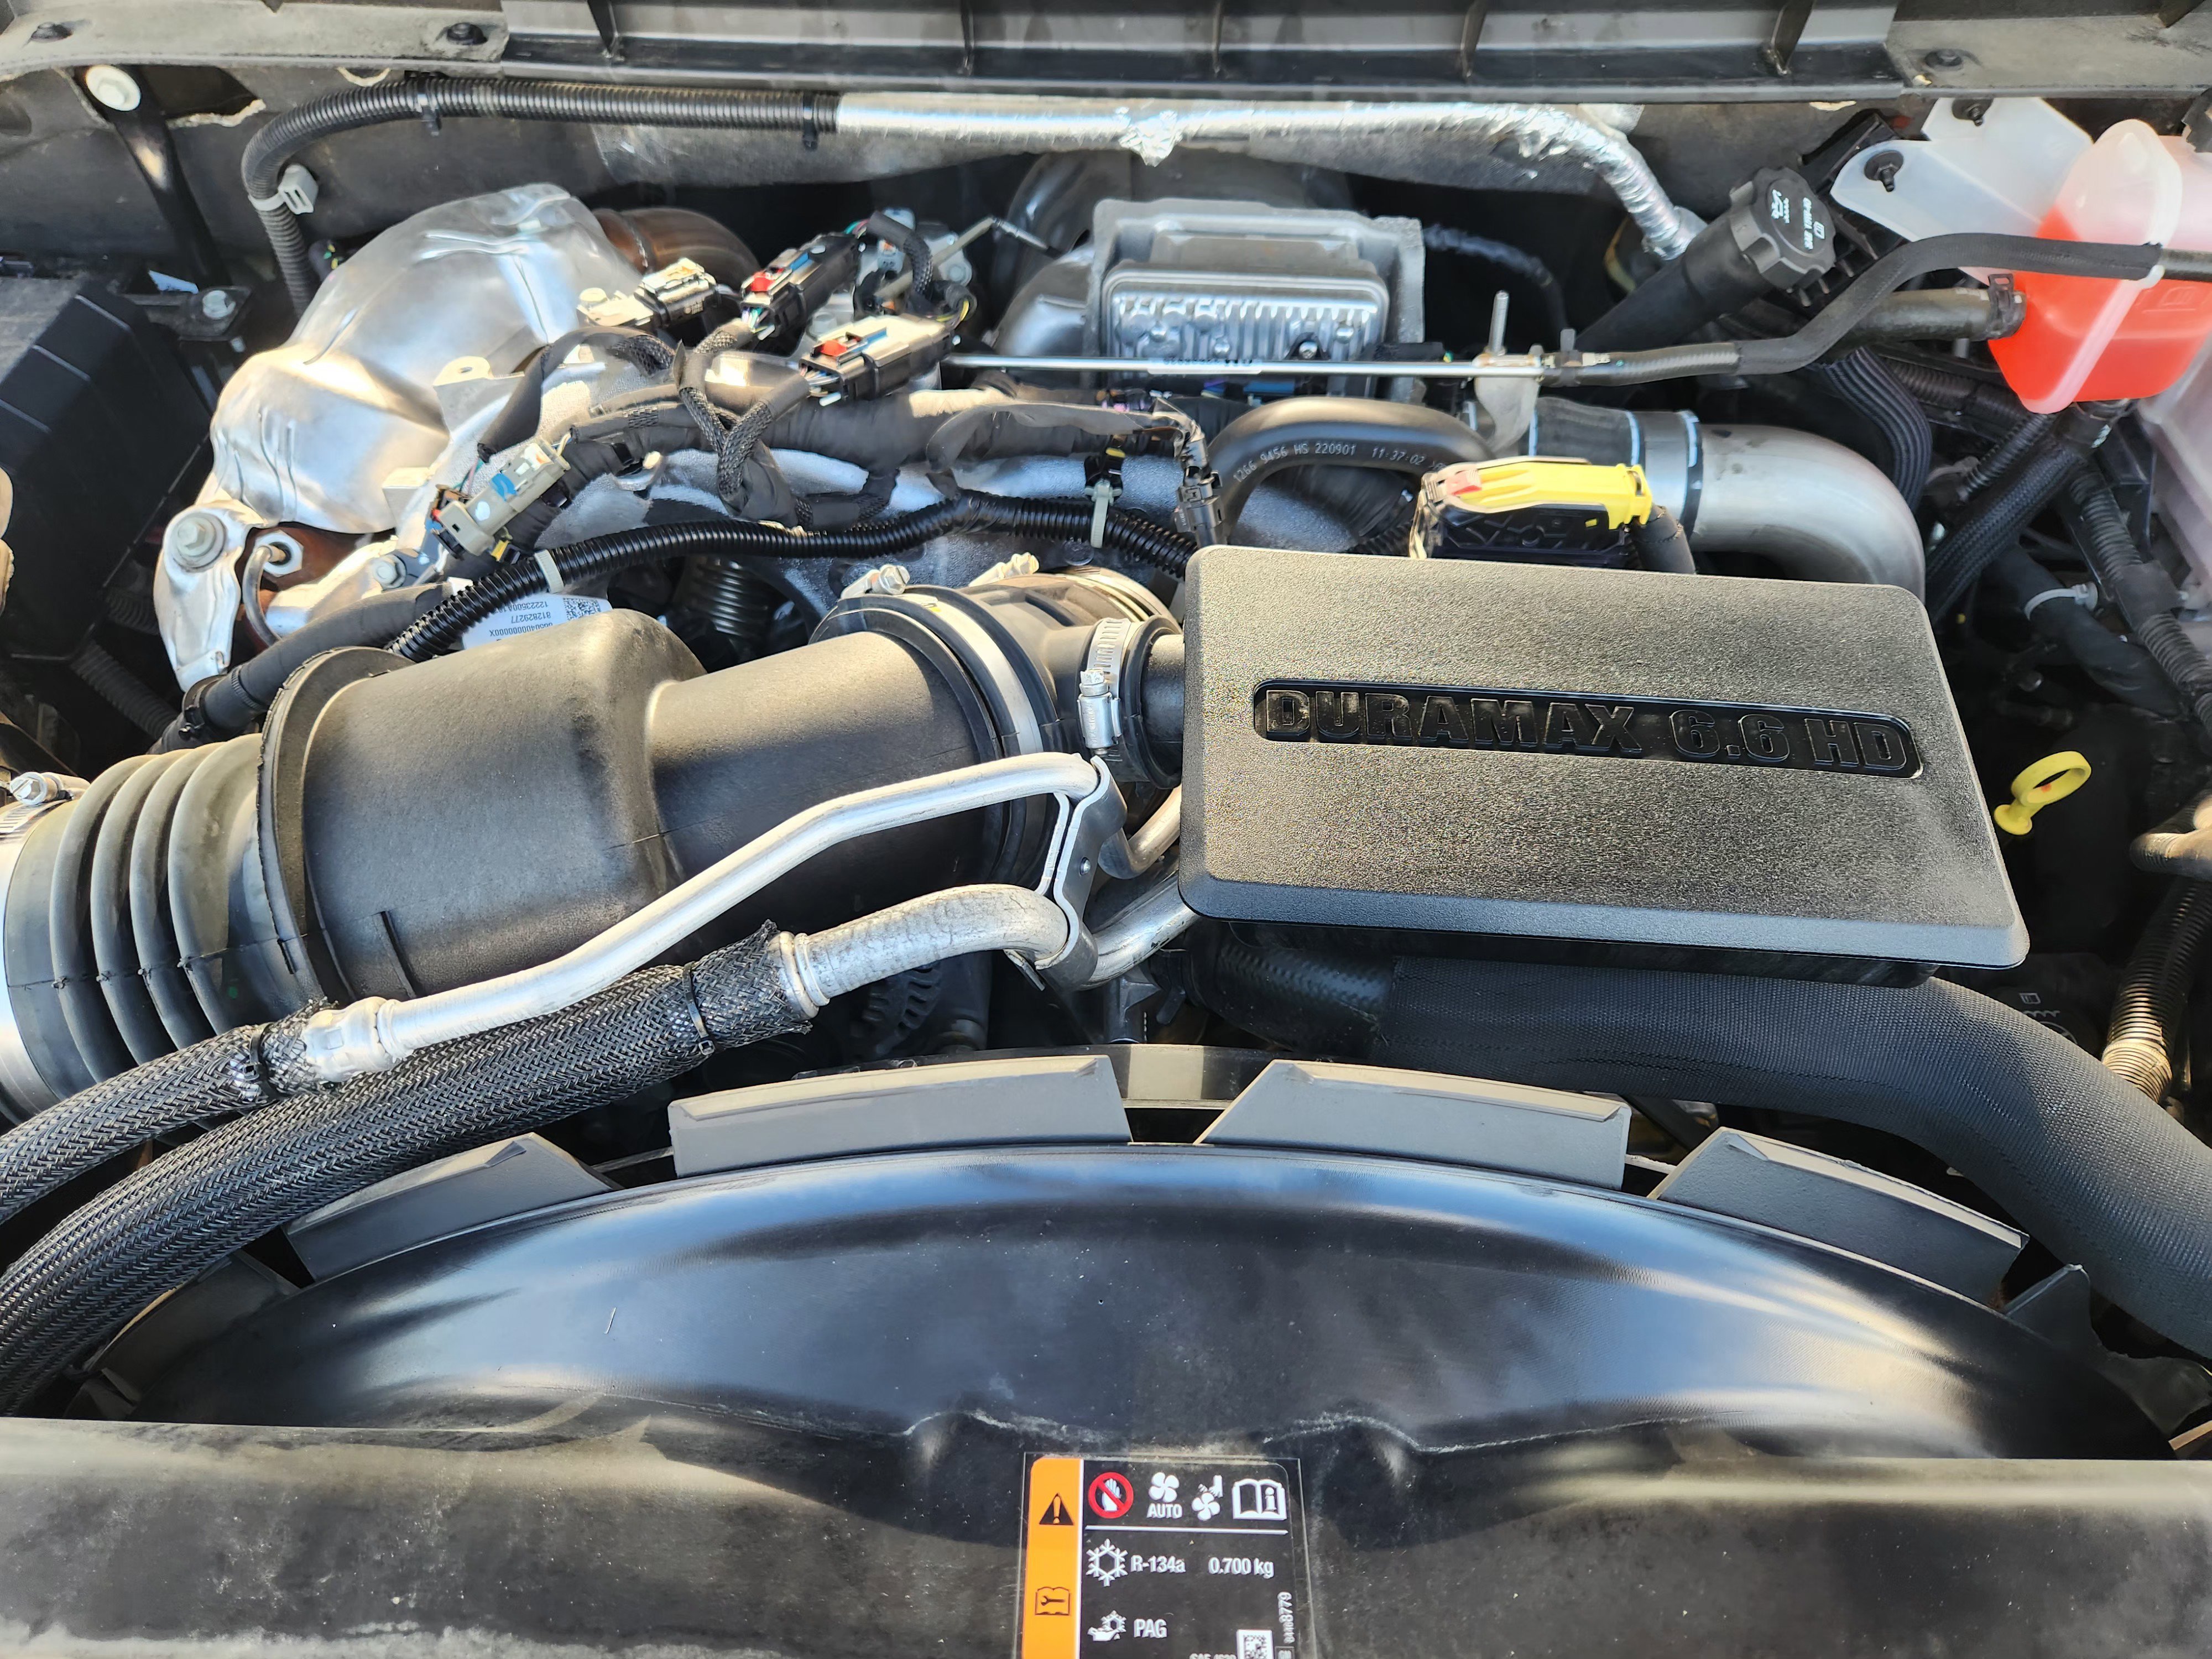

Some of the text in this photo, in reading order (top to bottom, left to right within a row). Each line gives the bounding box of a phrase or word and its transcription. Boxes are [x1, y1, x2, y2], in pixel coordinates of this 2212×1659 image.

[1233, 442, 1426, 482] 1266 9456 HS 220901 11:37:02
[511, 612, 551, 624] 812829277
[1266, 689, 1907, 770] DURAMAX 6.6 HD
[1147, 1503, 1183, 1519] AUTO
[1130, 1554, 1274, 1579] R-134a 0.700 kg
[1134, 1618, 1167, 1638] PAG
